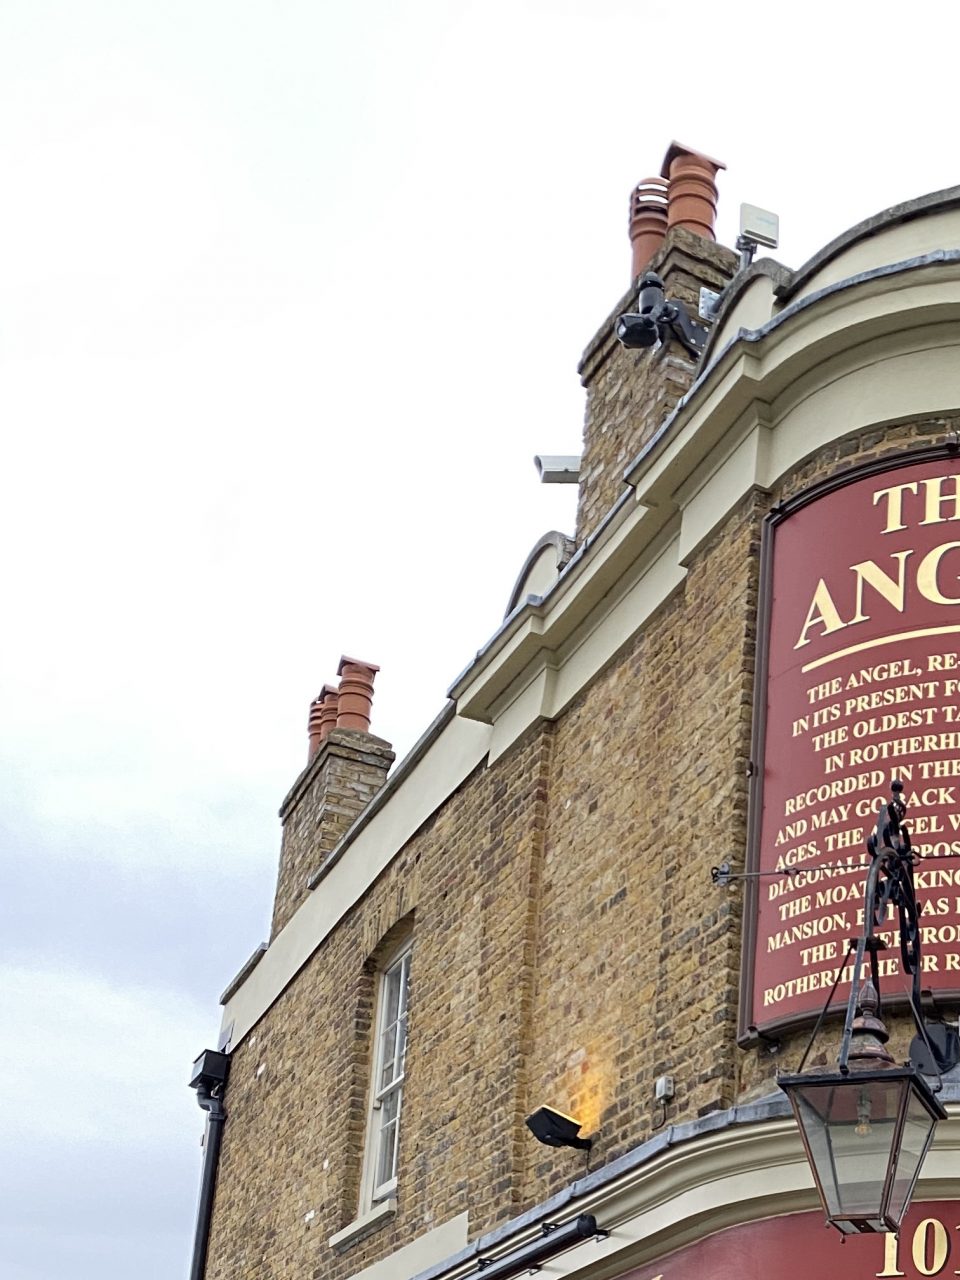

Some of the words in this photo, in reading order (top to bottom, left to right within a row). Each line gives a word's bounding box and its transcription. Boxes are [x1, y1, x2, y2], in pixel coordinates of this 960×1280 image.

[806, 677, 843, 704] THE
[845, 659, 923, 690] ANGEL,
[792, 715, 810, 737] IN
[812, 703, 841, 728] ITS
[844, 681, 940, 716] PRESENT
[812, 726, 849, 752] THE
[853, 708, 937, 738] OLDEST
[824, 752, 845, 774] IN
[785, 770, 885, 817] RECORDED
[890, 765, 913, 782] IN
[775, 819, 807, 847] AND
[811, 804, 852, 831] MAY
[855, 796, 887, 817] GO
[775, 841, 821, 872] AGES.
[825, 827, 864, 852] THE
[870, 815, 944, 839] GEL
[768, 853, 870, 901] DIAGONALL
[767, 912, 851, 953] MANSION,
[905, 897, 949, 919] AS
[778, 895, 811, 921] THE
[800, 942, 837, 966] THE
